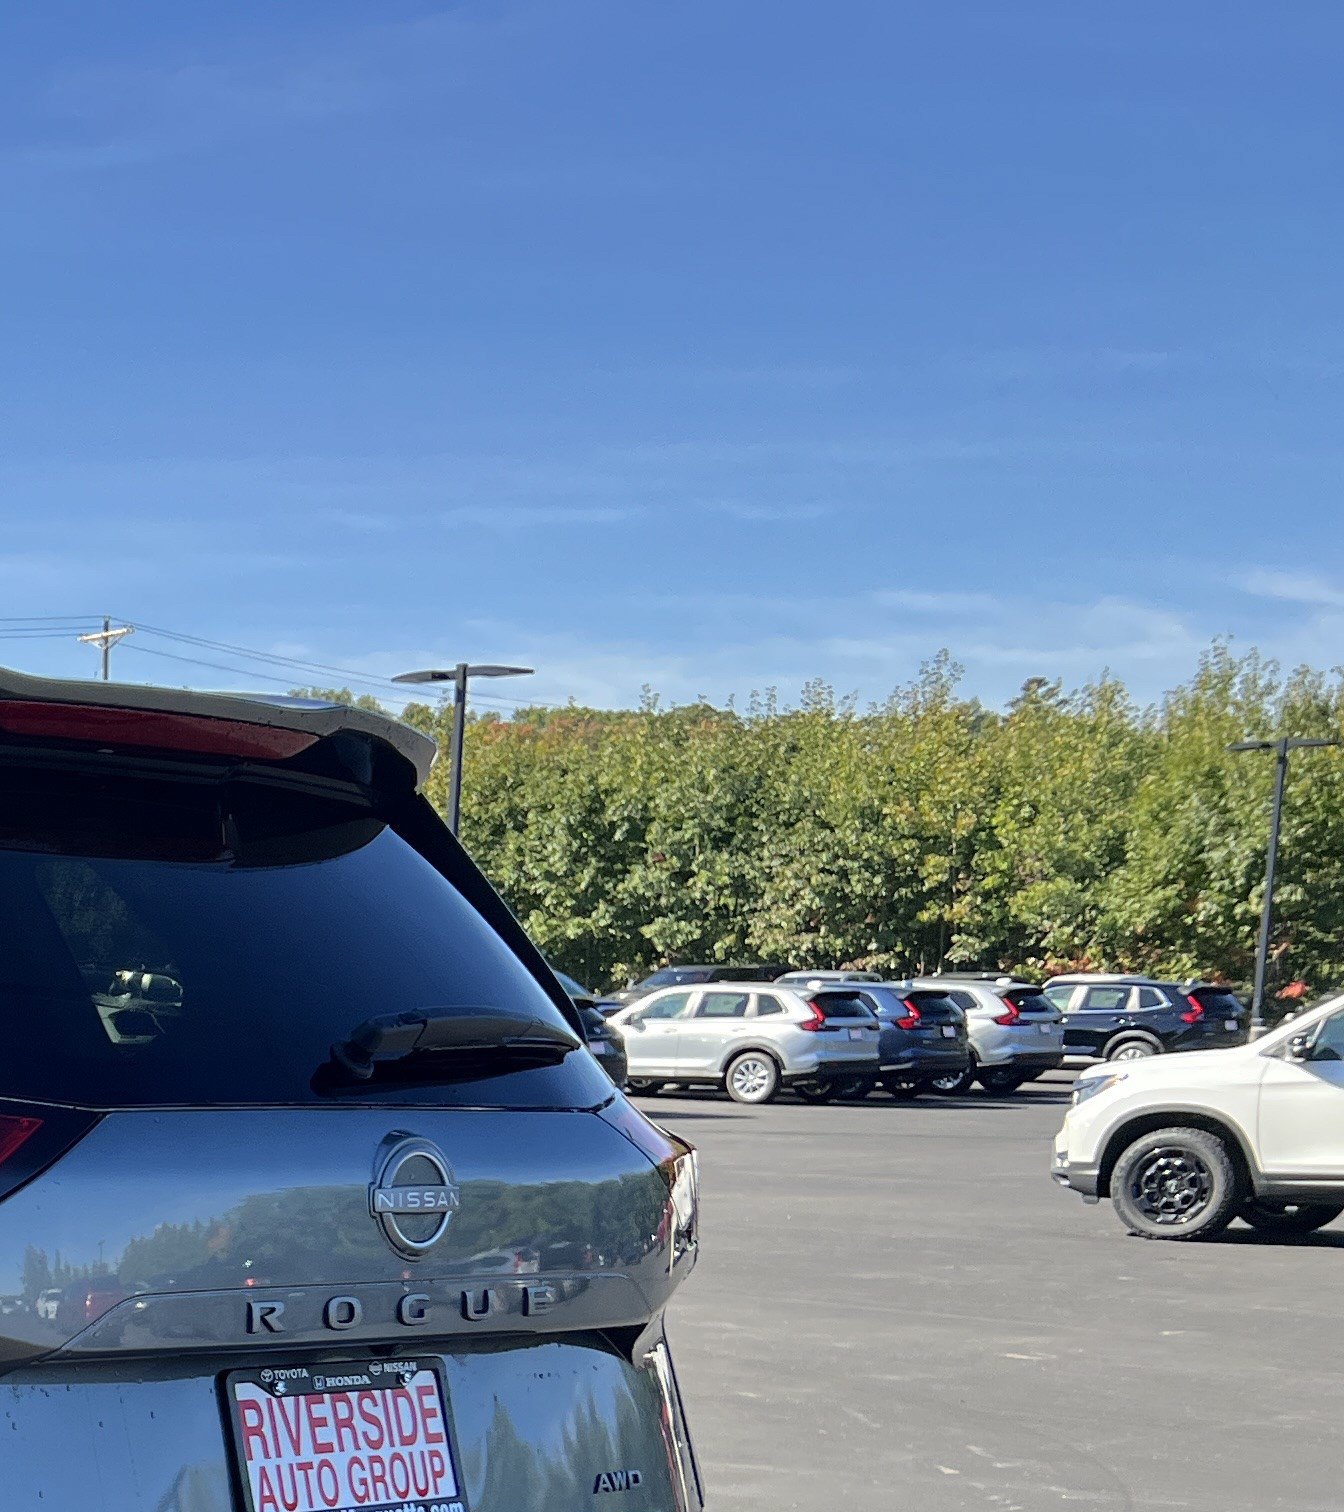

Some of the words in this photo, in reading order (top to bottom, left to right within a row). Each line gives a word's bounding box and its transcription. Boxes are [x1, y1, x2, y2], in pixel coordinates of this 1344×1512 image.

[378, 1191, 459, 1209] NISSAN
[246, 1286, 556, 1335] ROGUE
[273, 1368, 309, 1380] TOYOTA
[383, 1361, 417, 1374] NISSAN
[326, 1374, 372, 1387] HONDA
[237, 1385, 444, 1461] RIVERSIDE
[346, 1450, 446, 1505] GROUP
[596, 1469, 643, 1495] AWD
